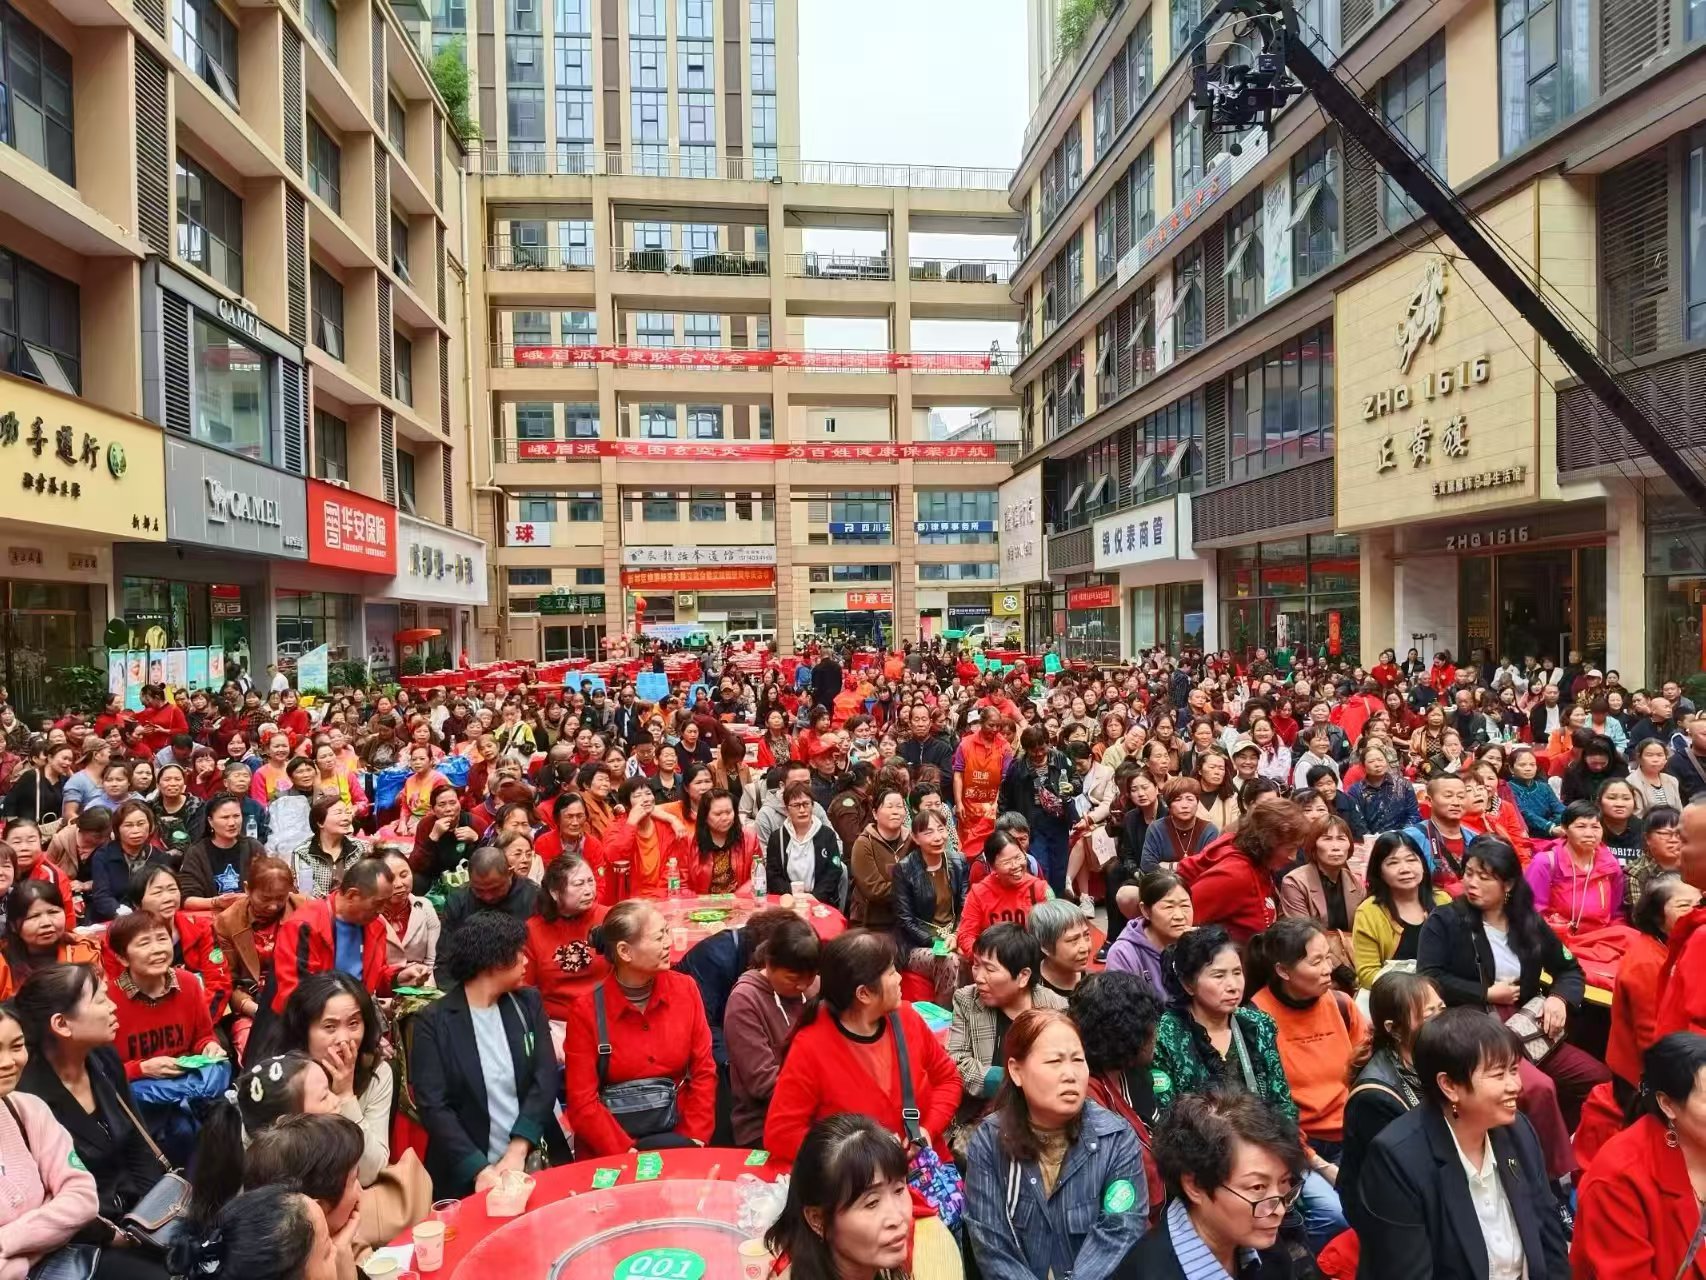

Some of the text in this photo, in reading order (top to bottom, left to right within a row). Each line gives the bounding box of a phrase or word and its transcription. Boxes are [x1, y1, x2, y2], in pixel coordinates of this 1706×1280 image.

[217, 298, 262, 340] CAMEL
[1361, 357, 1491, 420] ZHQ 1616
[1376, 415, 1470, 473] 正黄旗
[227, 491, 282, 527] CAMEL
[341, 506, 387, 546] 华安保险
[515, 523, 534, 542] 球
[1103, 516, 1163, 556] 锦悦泰商管
[1446, 525, 1529, 550] ZHQ 1616
[629, 1256, 692, 1278] 001
